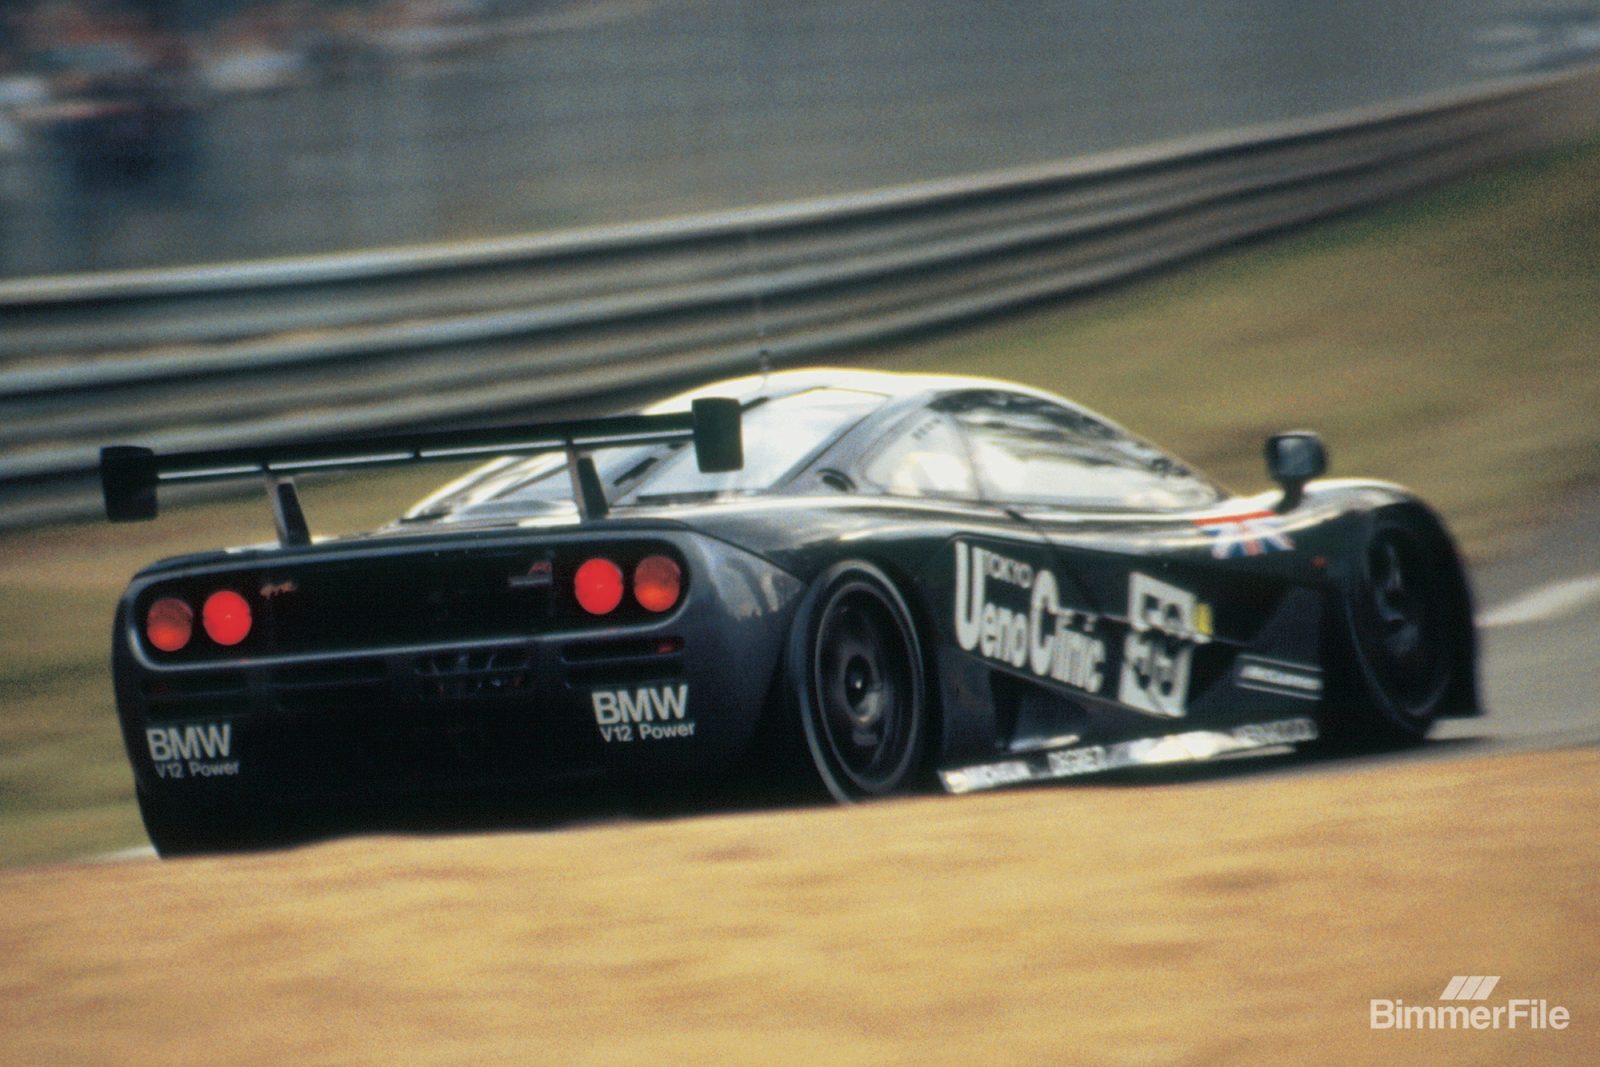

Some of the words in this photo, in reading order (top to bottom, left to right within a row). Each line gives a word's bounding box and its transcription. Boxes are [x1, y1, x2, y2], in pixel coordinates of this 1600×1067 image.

[983, 550, 1034, 588] TOKYO
[955, 541, 1028, 668] Ueno
[591, 684, 688, 725] BMW
[145, 723, 231, 761] BMW
[600, 725, 634, 743] V12
[639, 721, 695, 740] Power
[154, 762, 184, 779] V12
[188, 761, 240, 777] Power
